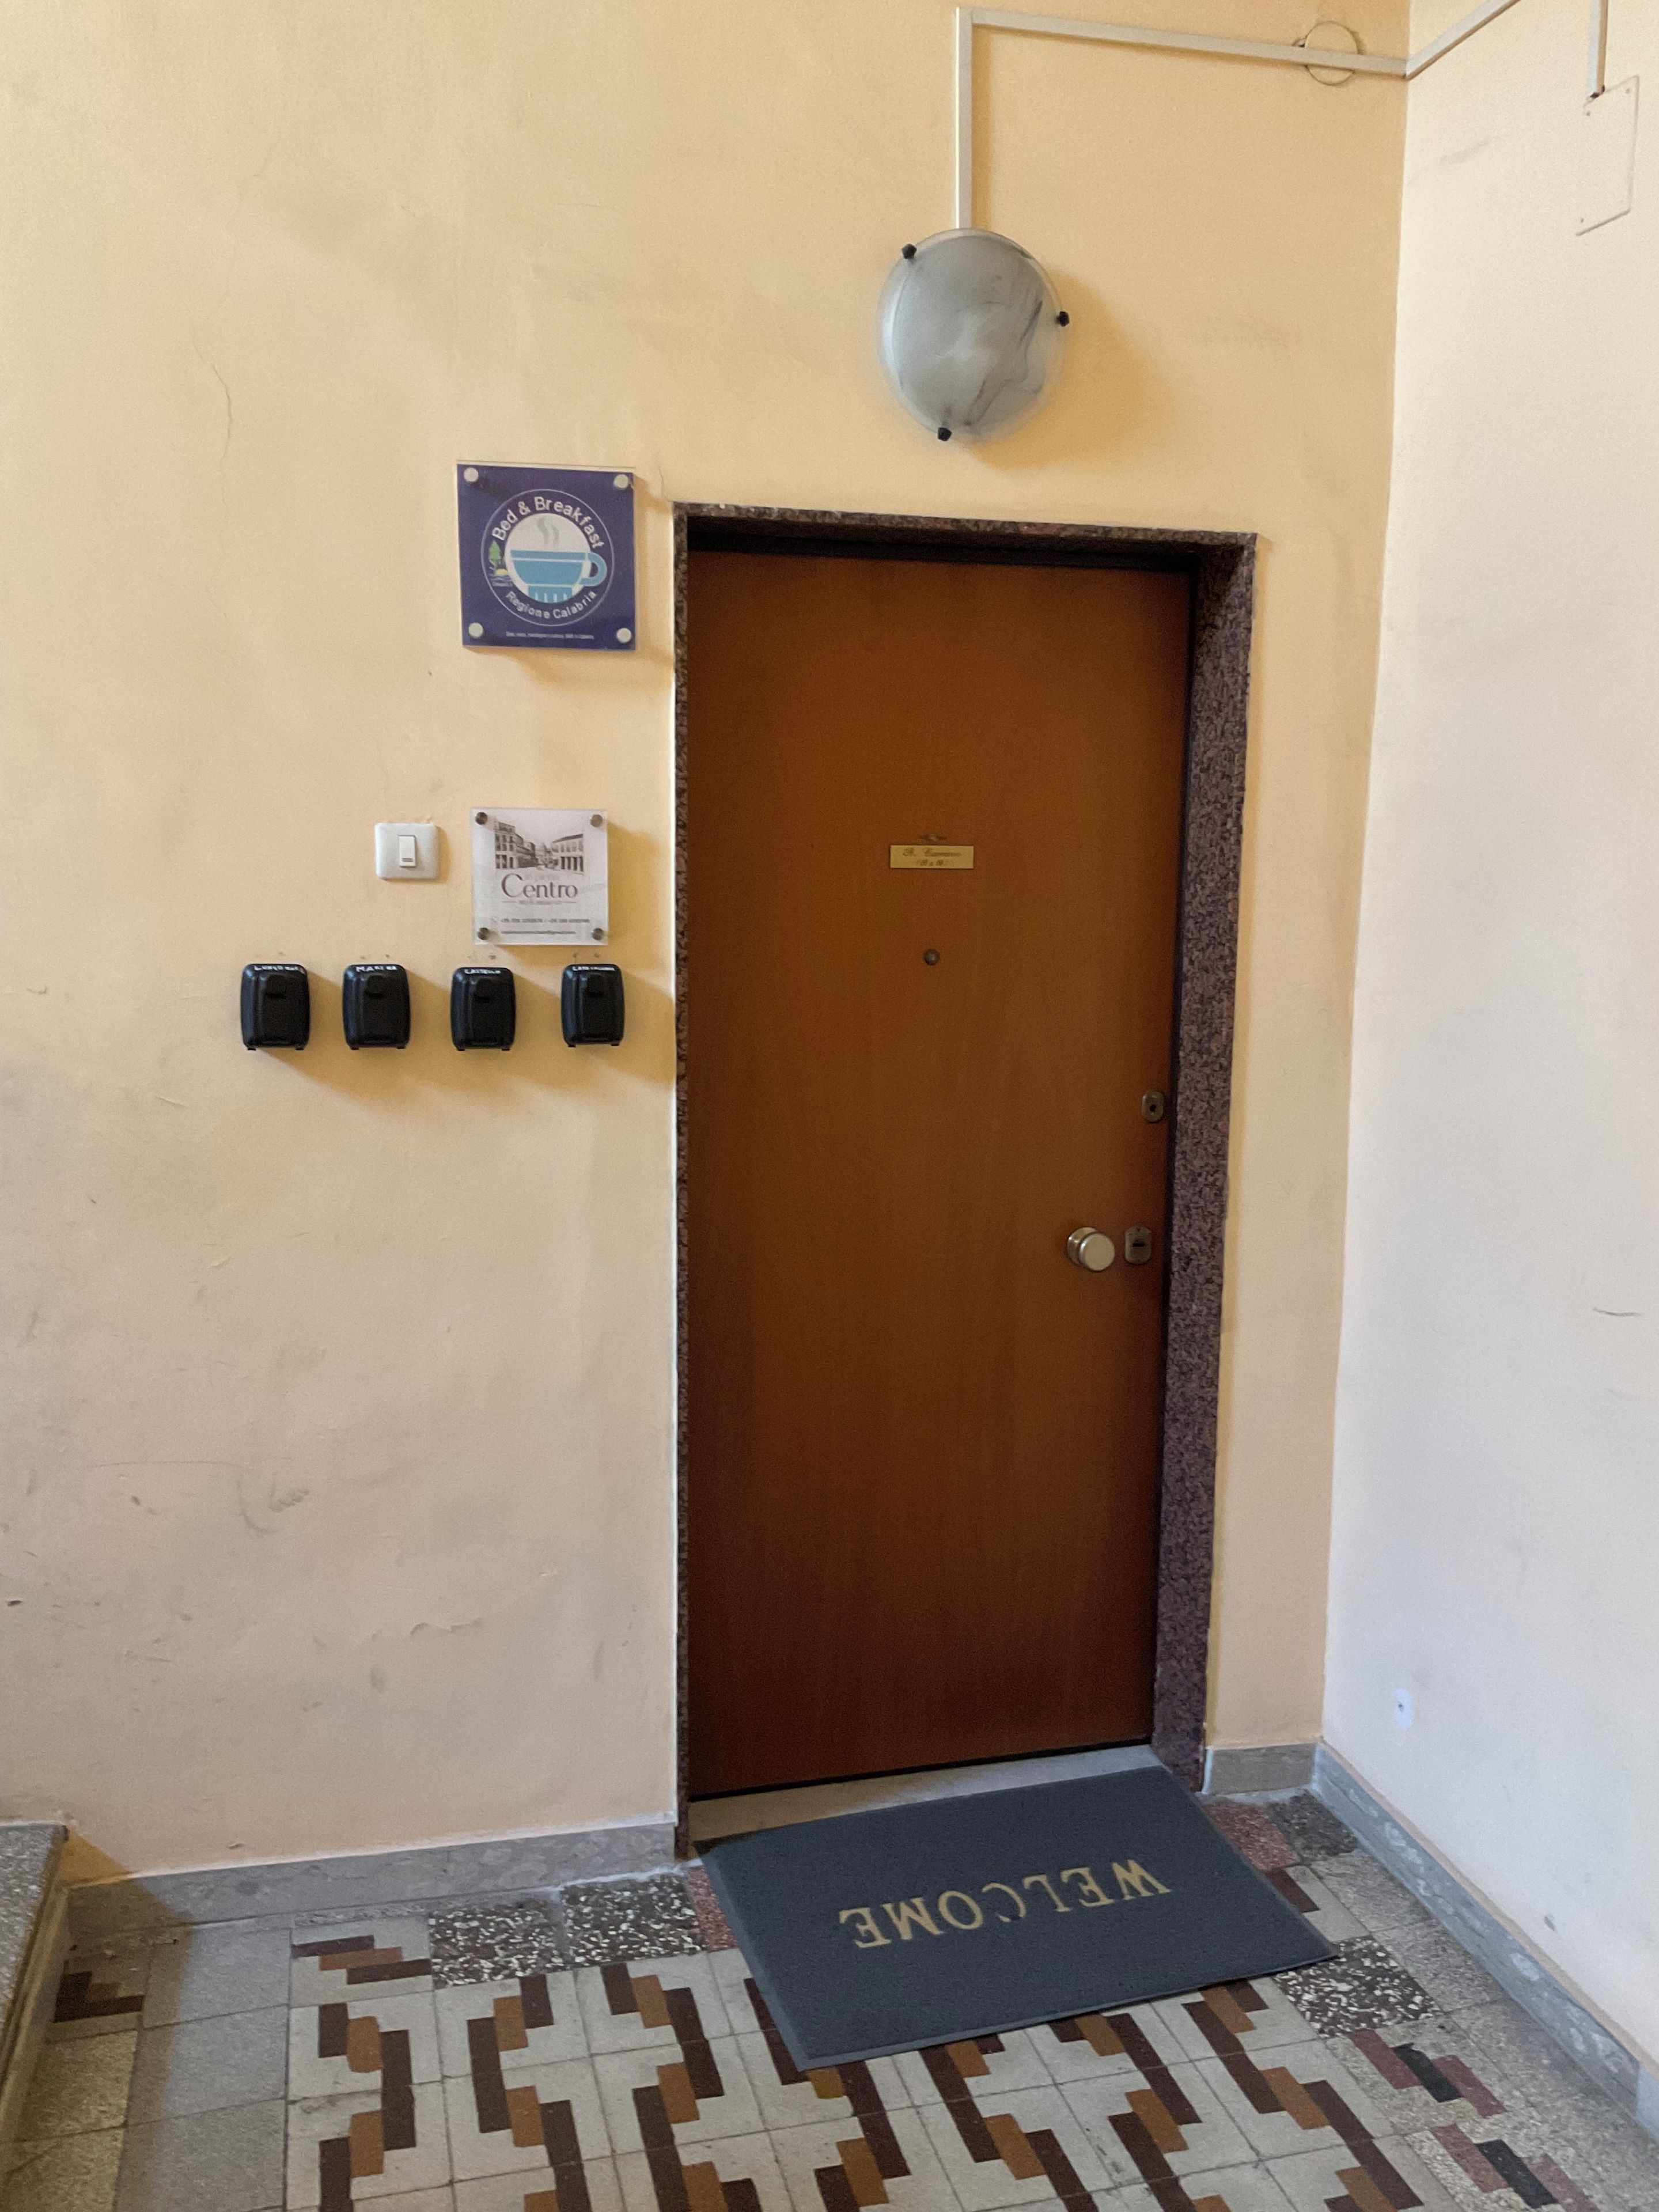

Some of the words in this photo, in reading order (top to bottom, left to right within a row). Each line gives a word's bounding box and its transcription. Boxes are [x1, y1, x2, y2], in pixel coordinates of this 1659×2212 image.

[492, 509, 517, 541] Bed
[518, 501, 531, 515] &
[534, 496, 605, 549] Breakfast
[505, 590, 551, 619] Regione
[552, 590, 597, 619] Calabria
[501, 873, 578, 898] Centro
[839, 1859, 1172, 1949] WELCOME
